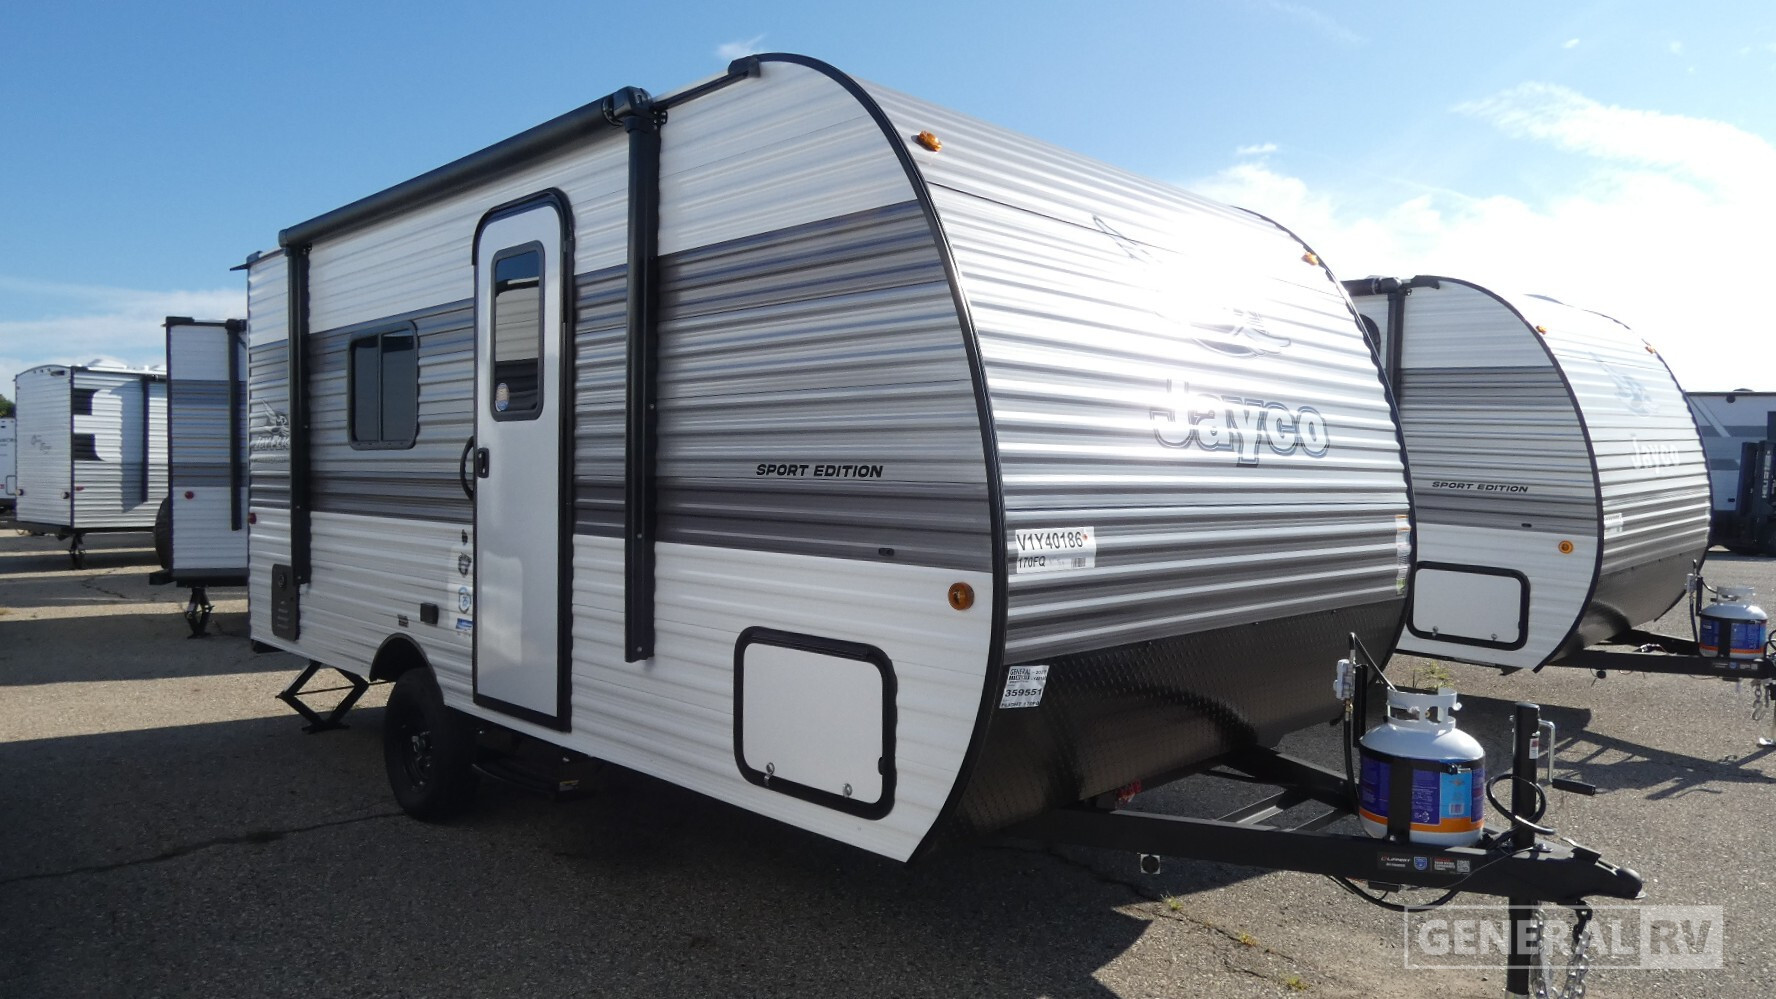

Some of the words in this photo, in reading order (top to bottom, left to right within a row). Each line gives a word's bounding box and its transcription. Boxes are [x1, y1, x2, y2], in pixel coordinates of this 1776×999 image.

[1150, 378, 1330, 468] Jayco
[1631, 434, 1680, 475] Jayco
[756, 463, 809, 477] SPORT
[813, 464, 883, 478] EDITION
[1432, 481, 1474, 490] SPORT
[1477, 483, 1528, 493] EDITION
[1016, 531, 1083, 551] V1Y40186
[1017, 555, 1046, 569] 170FQ
[1005, 688, 1042, 697] 359551
